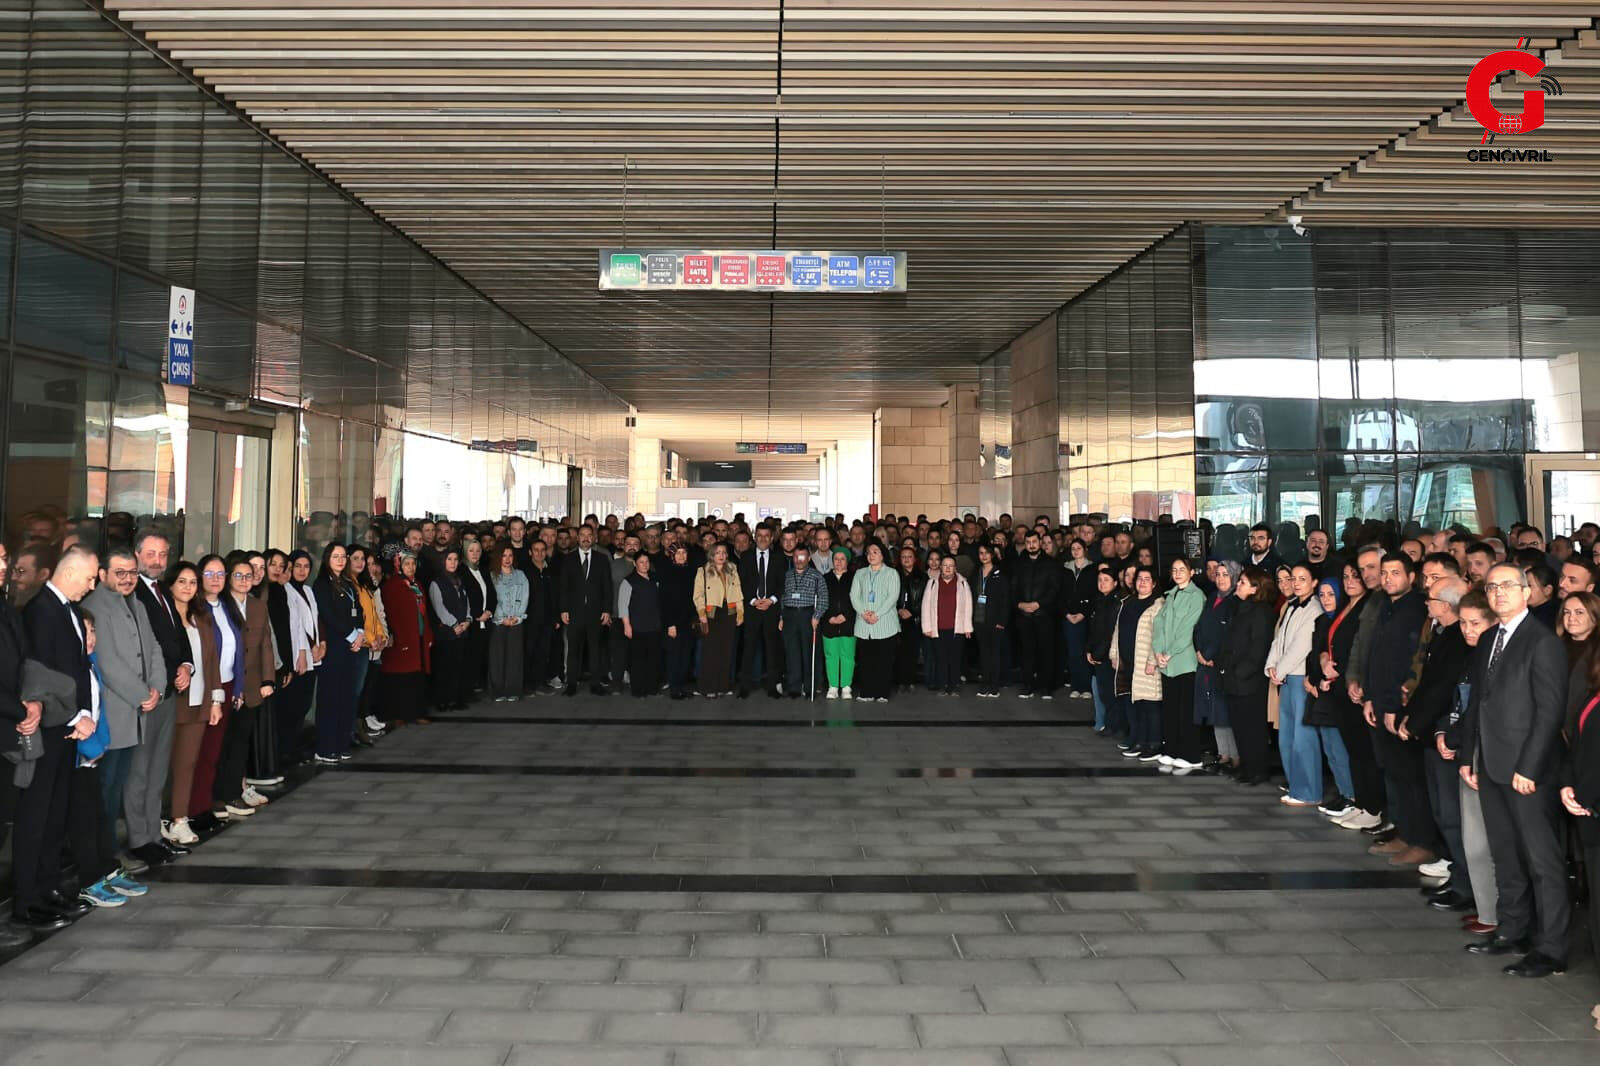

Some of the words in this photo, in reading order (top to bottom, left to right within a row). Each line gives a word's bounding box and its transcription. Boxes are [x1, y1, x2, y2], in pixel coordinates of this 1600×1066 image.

[689, 268, 707, 277] SATIŞ
[173, 342, 189, 357] YAYA
[171, 362, 191, 379] ÇIKIŞI
